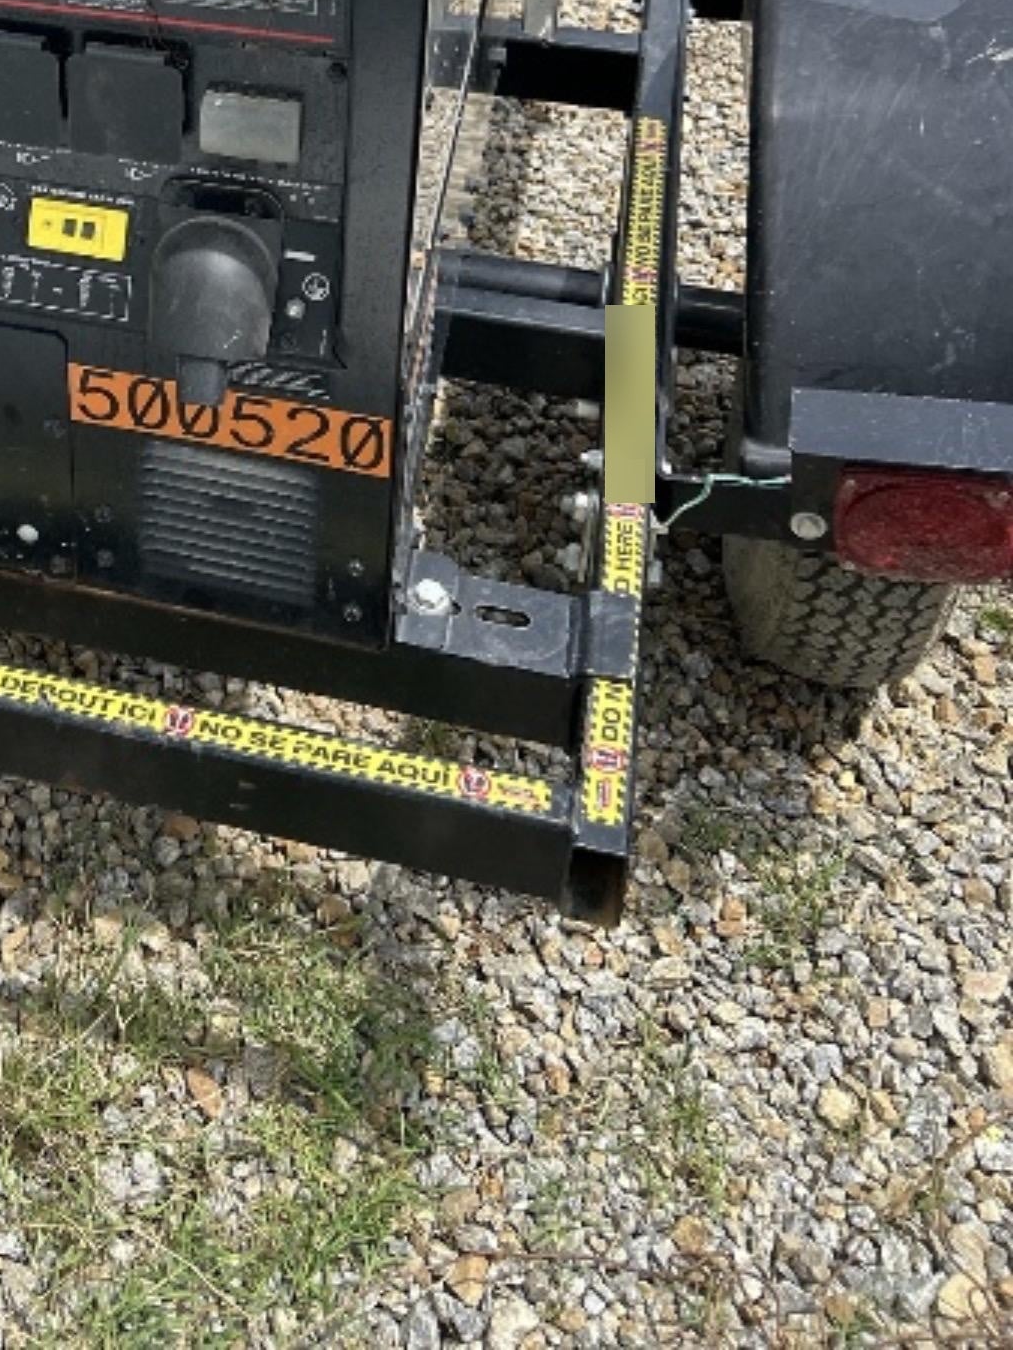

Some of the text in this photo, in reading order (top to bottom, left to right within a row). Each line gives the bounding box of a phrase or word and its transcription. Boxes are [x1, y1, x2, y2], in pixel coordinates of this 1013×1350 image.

[76, 367, 385, 469] 500520
[615, 521, 634, 570] HERE
[119, 701, 158, 721] ICI
[601, 707, 621, 742] DO
[199, 718, 241, 742] NO
[247, 731, 288, 752] SE
[292, 741, 369, 770] PARE
